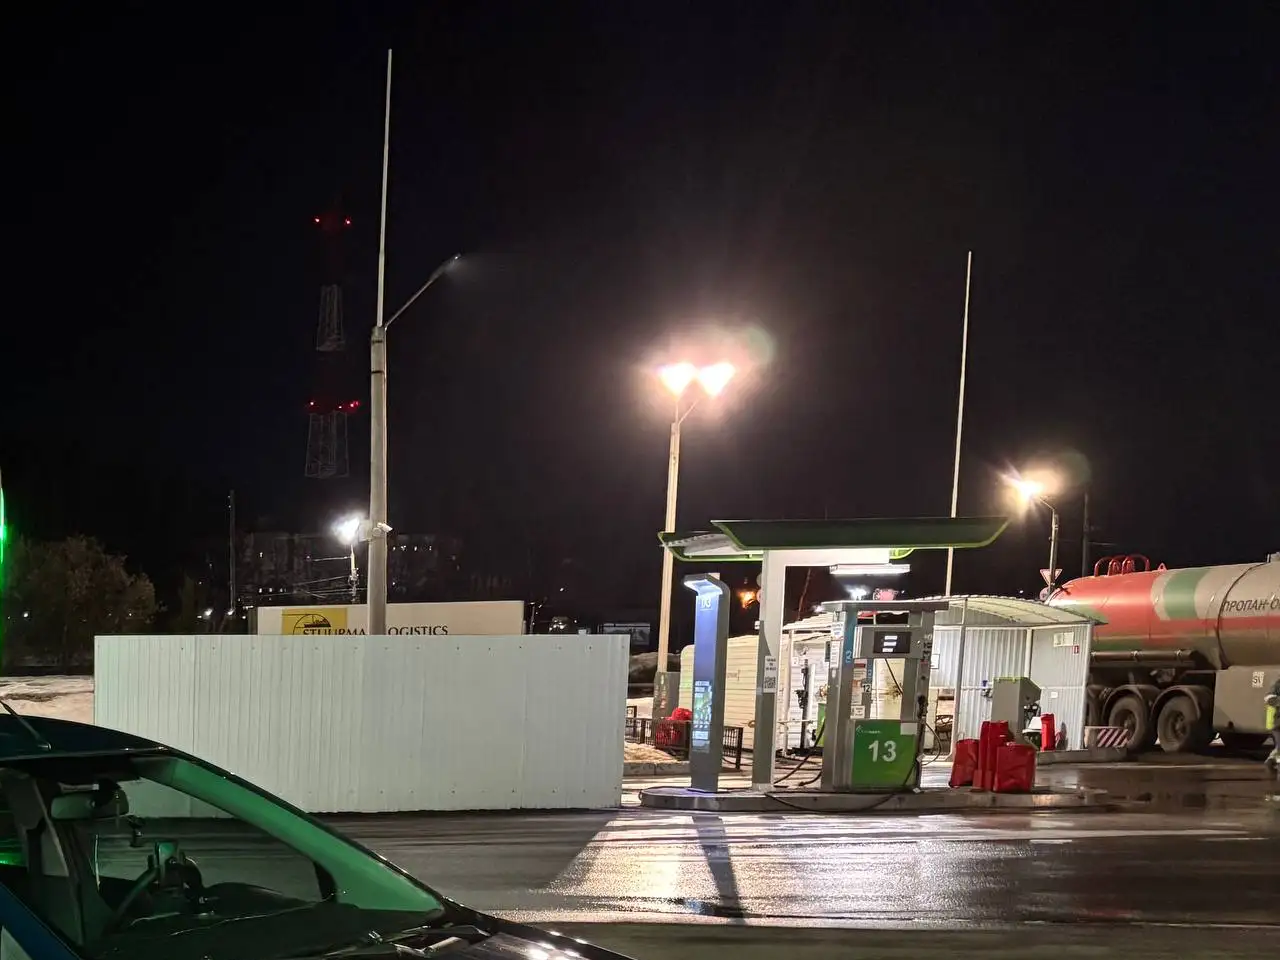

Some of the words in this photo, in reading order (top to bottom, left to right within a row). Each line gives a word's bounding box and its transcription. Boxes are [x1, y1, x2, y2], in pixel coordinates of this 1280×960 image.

[1221, 598, 1280, 612] ПРОПАН-О
[302, 628, 366, 636] STUURMA
[387, 625, 449, 636] OGISTICS
[868, 739, 897, 763] 13
